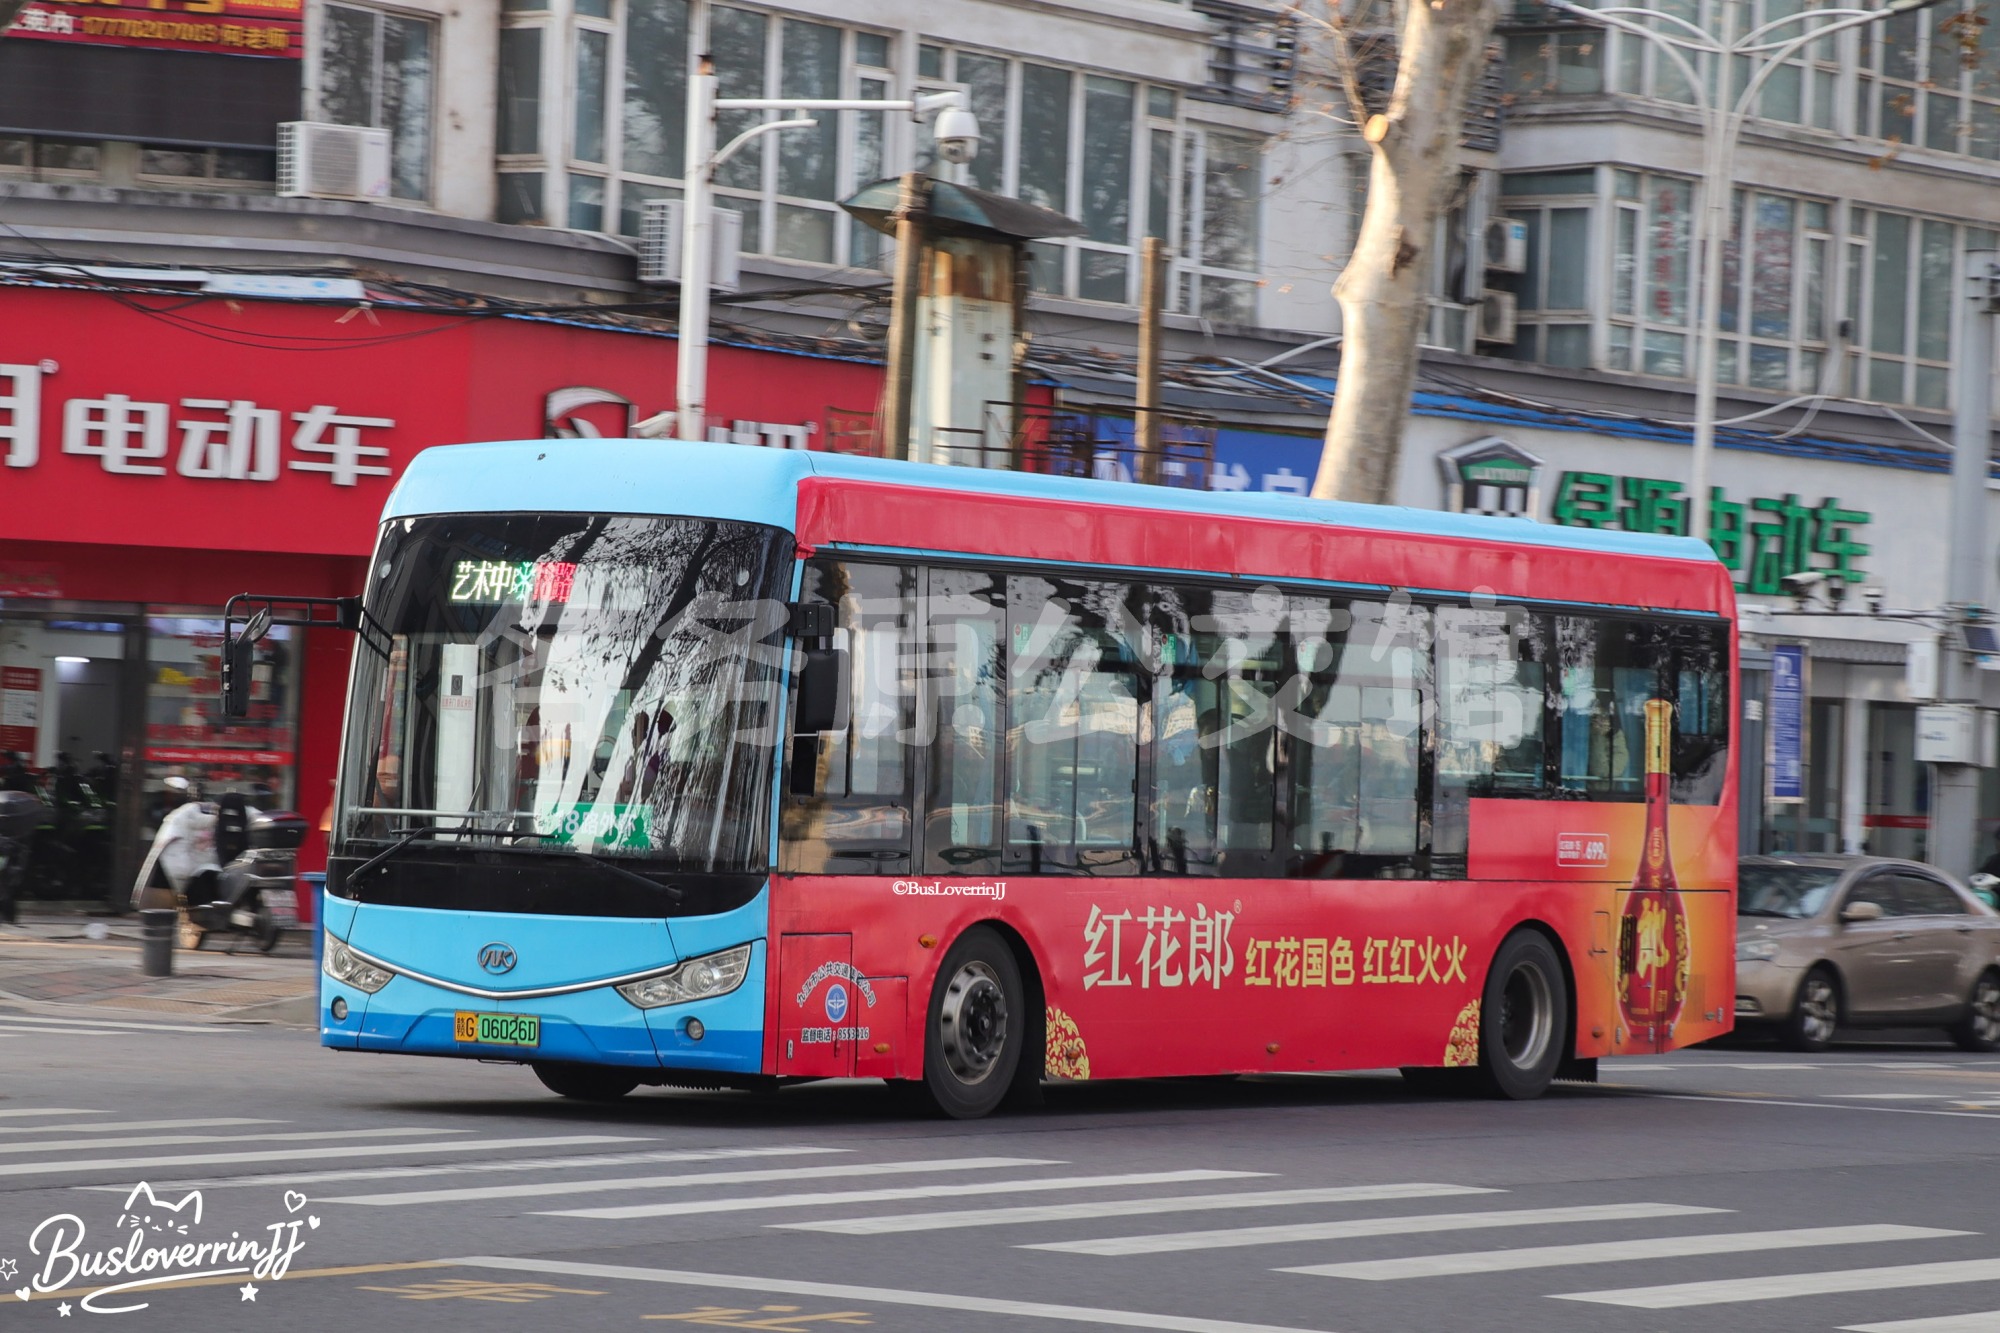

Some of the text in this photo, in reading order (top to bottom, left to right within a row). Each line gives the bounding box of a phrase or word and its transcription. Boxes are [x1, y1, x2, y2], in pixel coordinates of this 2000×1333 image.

[451, 560, 520, 601] 艺术中
[1083, 903, 1235, 990] 红花郎
[1245, 936, 1468, 988] 红花国色 红红火火
